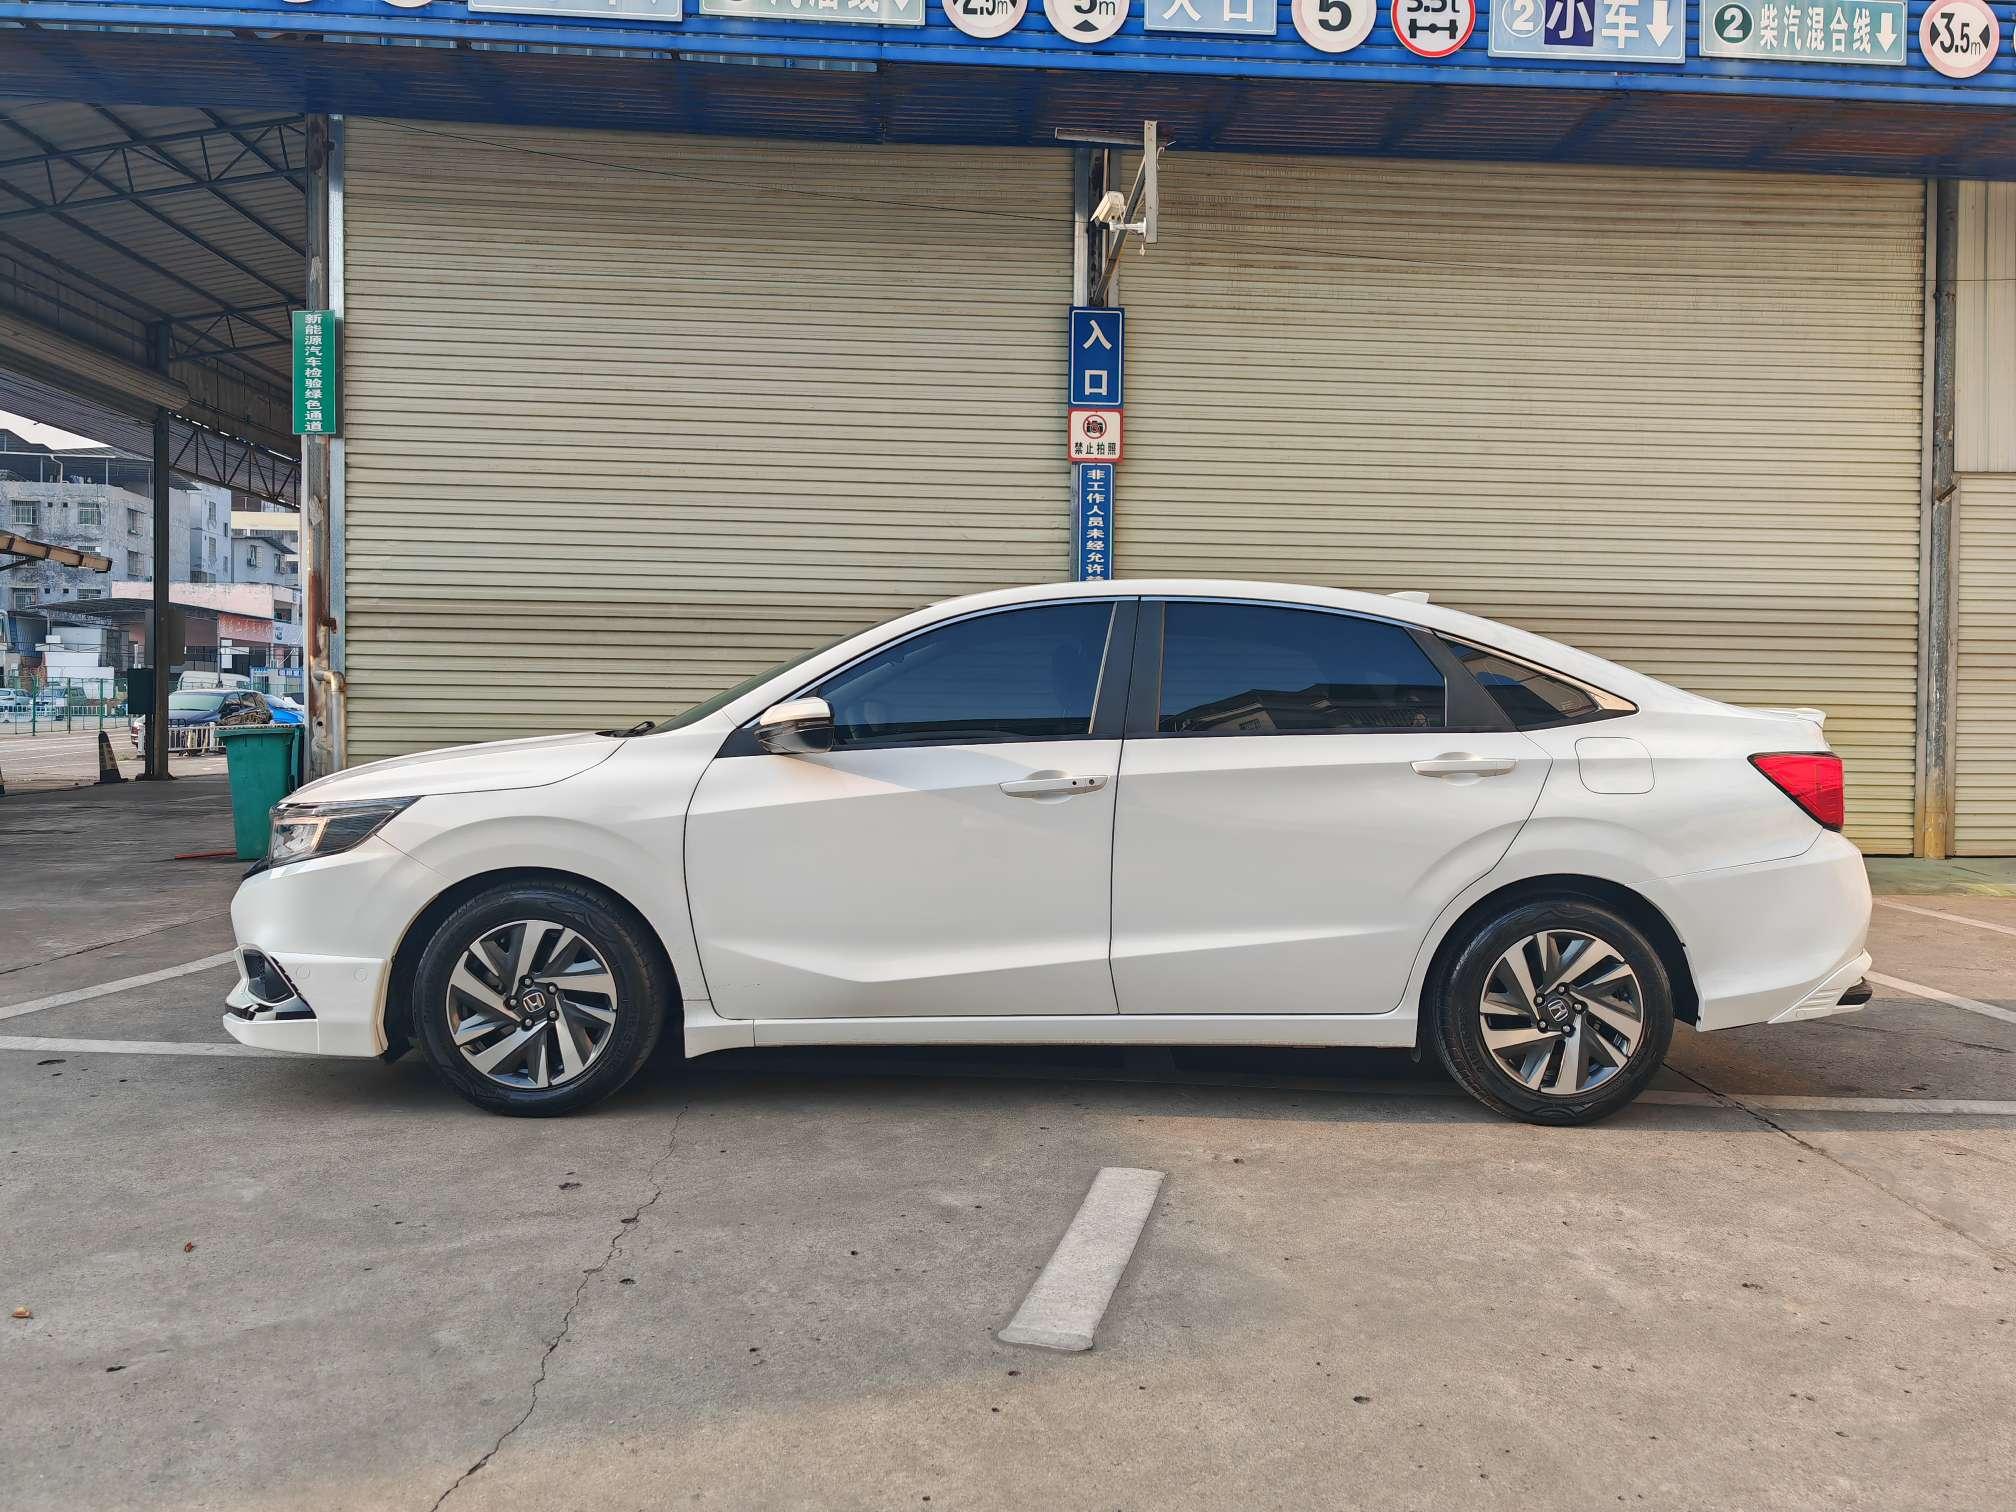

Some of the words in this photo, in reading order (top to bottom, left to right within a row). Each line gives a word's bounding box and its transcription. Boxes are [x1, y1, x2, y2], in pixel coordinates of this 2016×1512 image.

[1318, 0, 1352, 32] 5
[1940, 12, 1981, 56] 3.5m
[304, 314, 323, 432] 新能源汽车检验绿色通道
[1083, 319, 1112, 396] 入口
[1074, 441, 1117, 456] 禁止拍照
